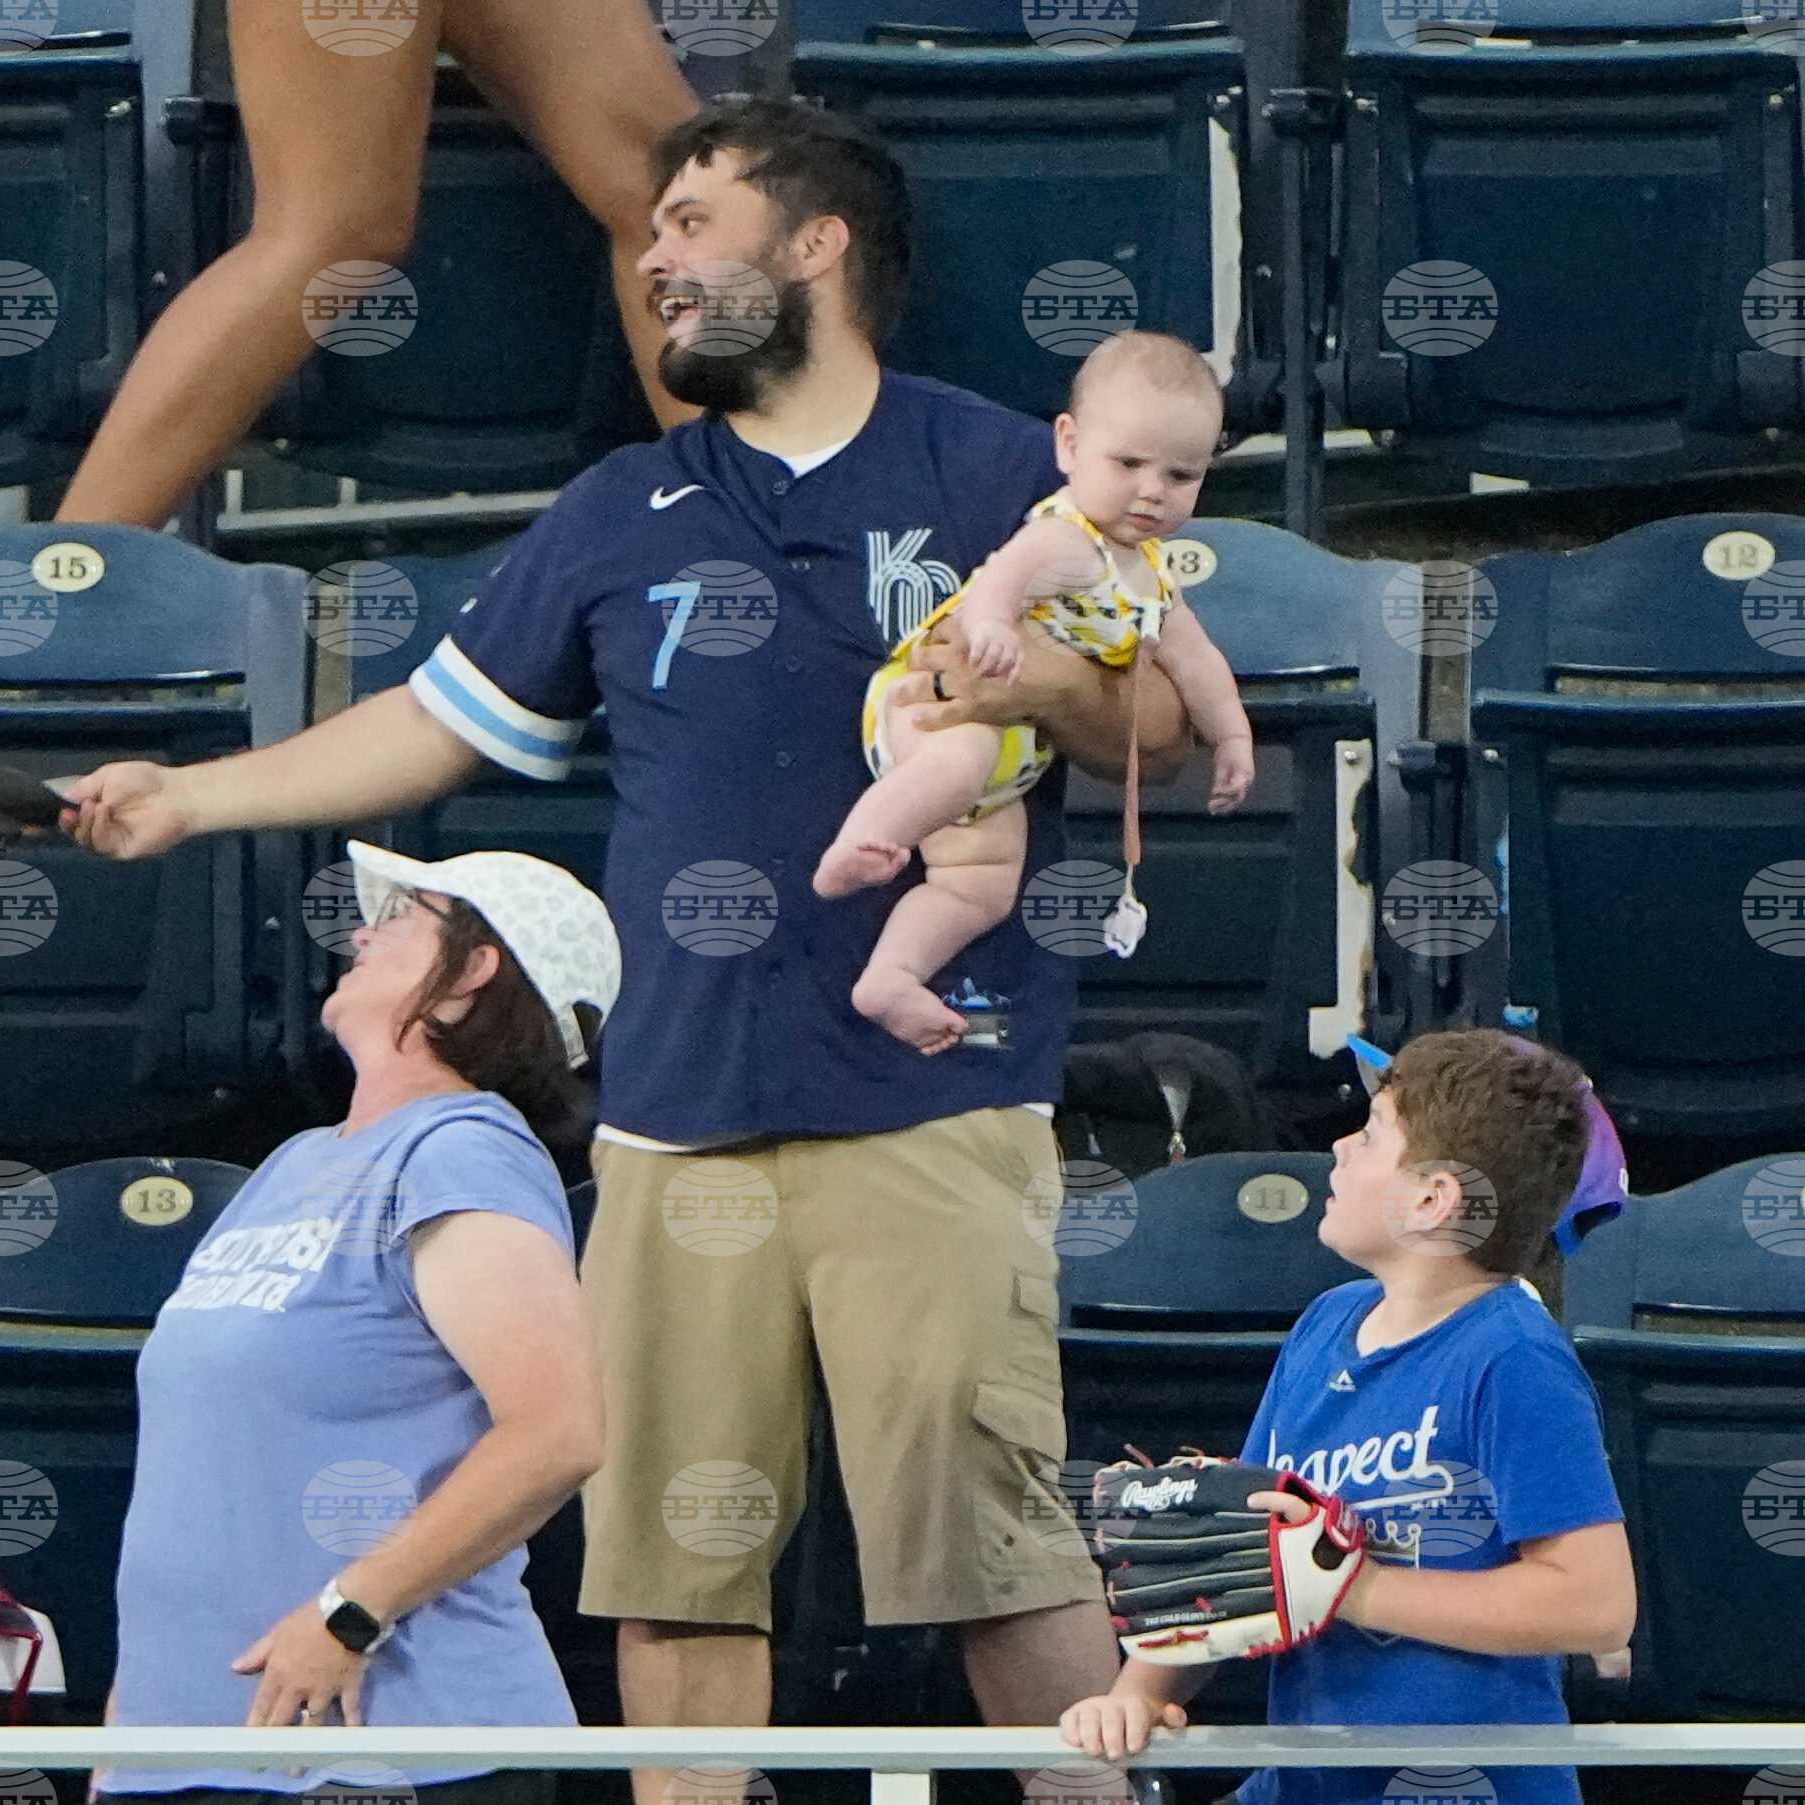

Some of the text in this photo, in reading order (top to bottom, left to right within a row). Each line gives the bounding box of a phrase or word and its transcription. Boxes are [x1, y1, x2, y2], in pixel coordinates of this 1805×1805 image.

[49, 557, 88, 580] 15
[648, 580, 701, 691] 7
[138, 1188, 177, 1213] 13
[1121, 1476, 1198, 1511] Rawlings
